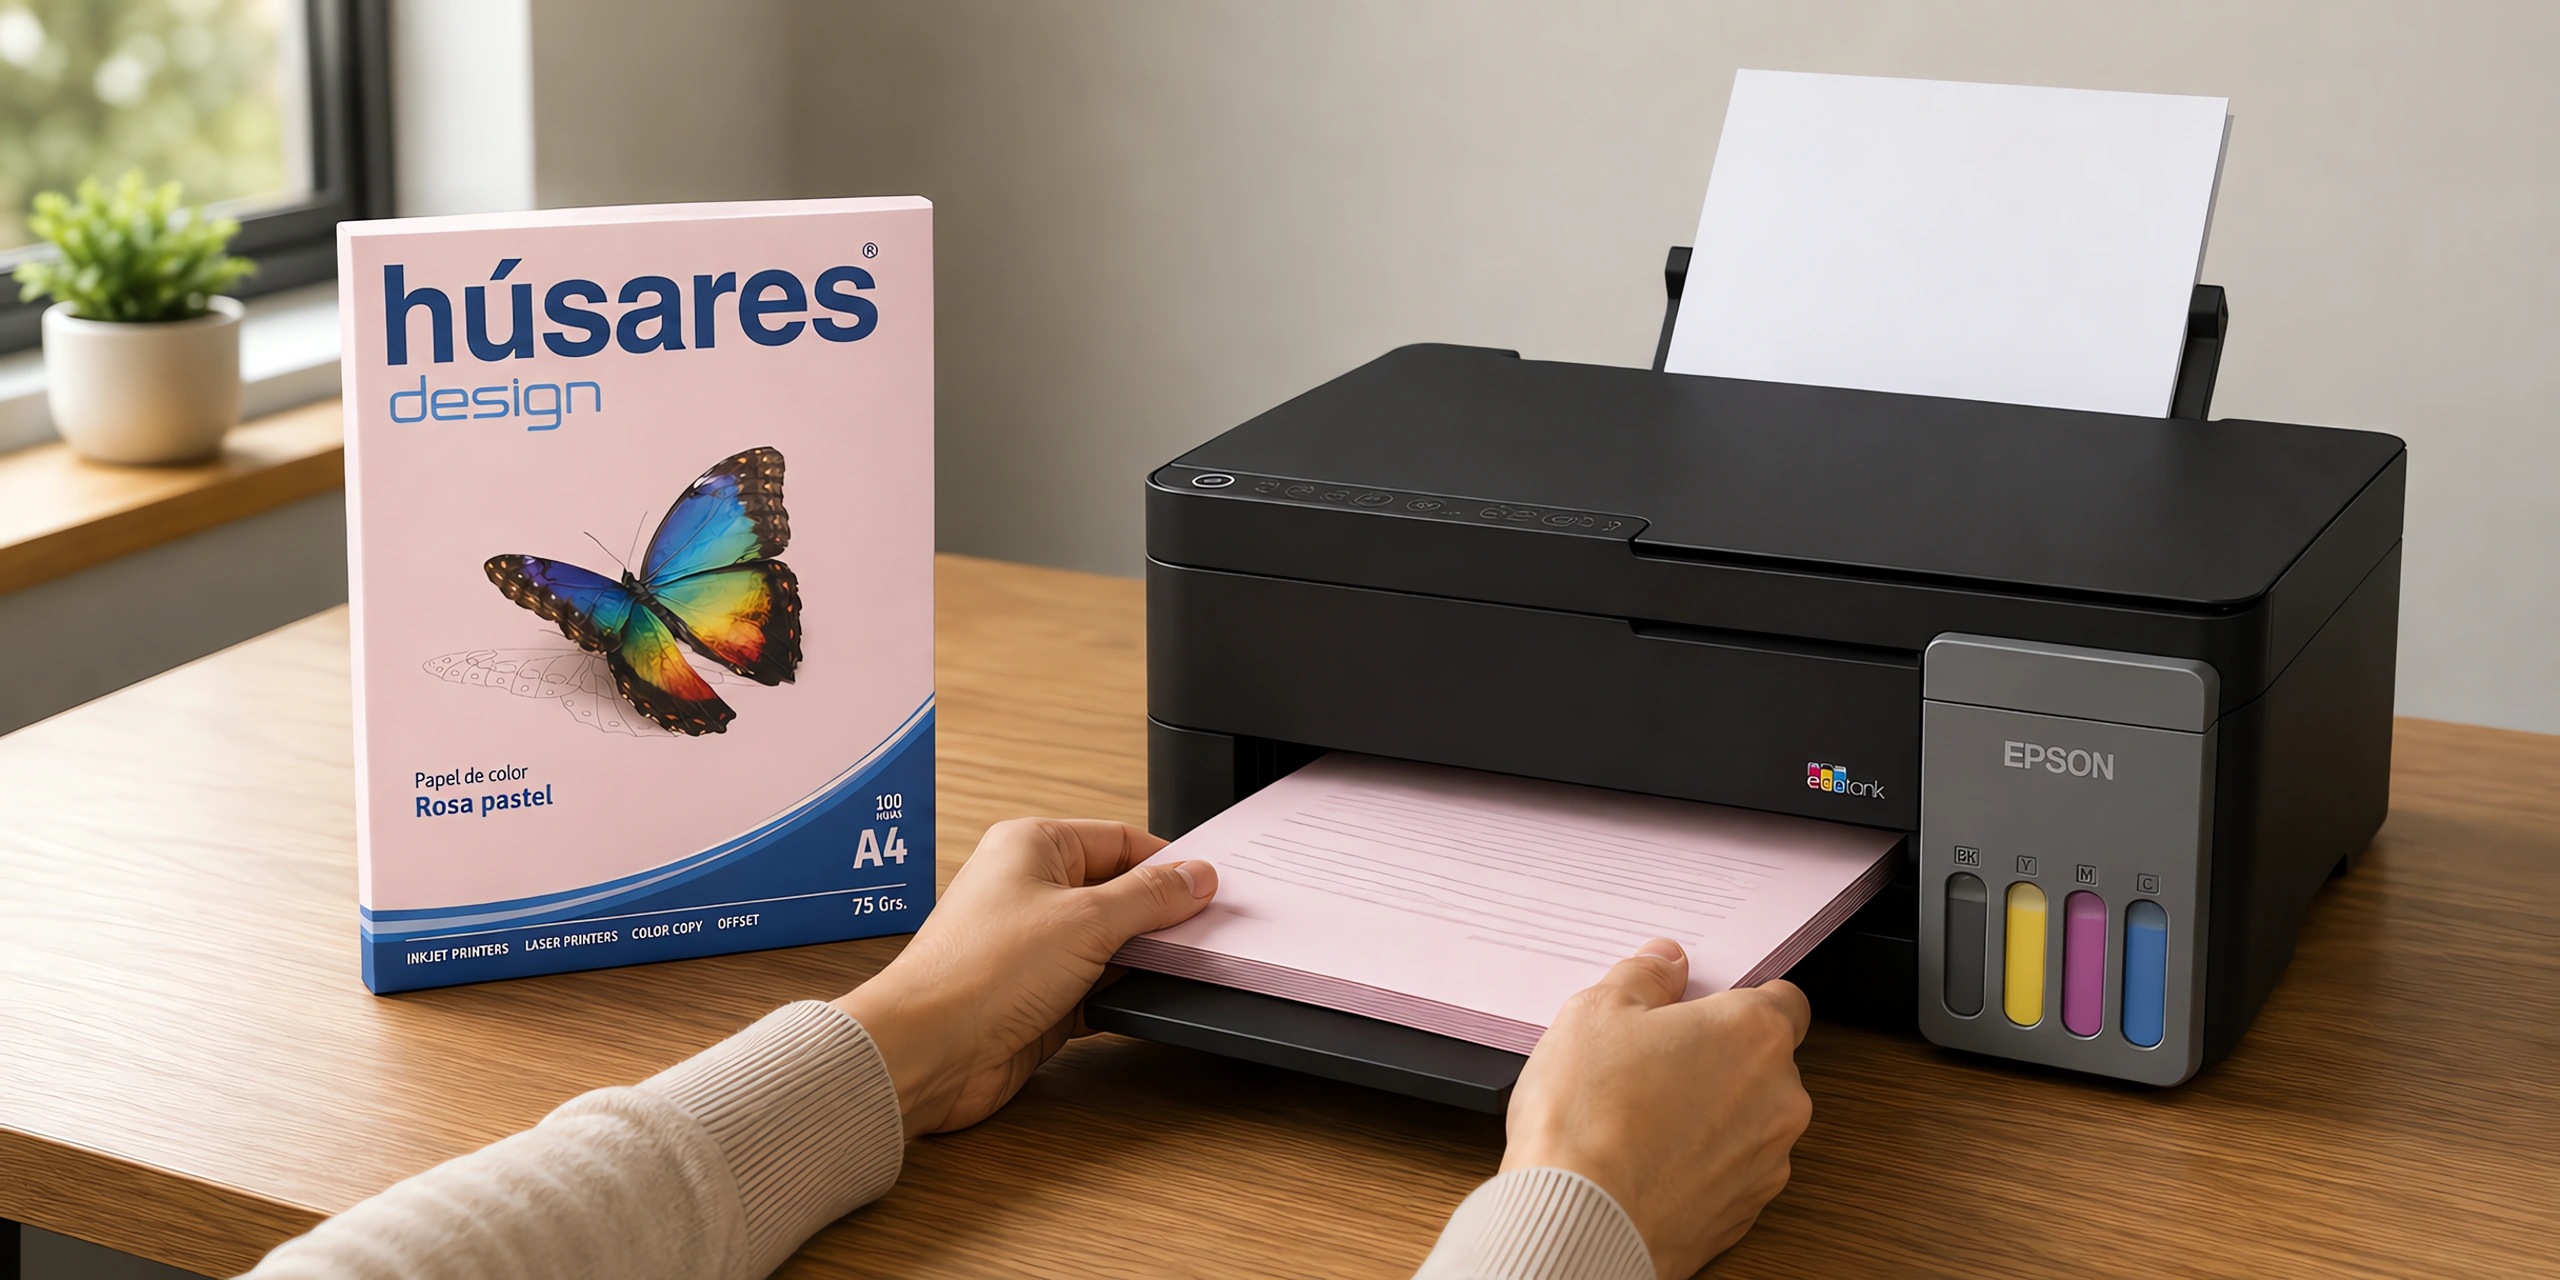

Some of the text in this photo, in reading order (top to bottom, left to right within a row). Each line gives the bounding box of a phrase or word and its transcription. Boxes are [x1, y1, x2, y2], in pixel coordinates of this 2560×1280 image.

[383, 258, 879, 366] húsares
[389, 375, 602, 432] design
[2003, 740, 2115, 781] EPSON
[415, 764, 528, 791] Papel de color
[416, 783, 553, 818] Rosa pastel
[875, 793, 903, 811] 100
[853, 826, 908, 869] A4
[1957, 849, 1977, 865] BK
[2021, 858, 2032, 872] Y
[2079, 867, 2093, 883] M
[2142, 877, 2154, 891] C
[852, 895, 908, 916] 75 Grs.
[631, 920, 703, 940] COLOR COPY
[717, 913, 760, 930] OFFSET
[525, 930, 619, 952] LASER PRINTERS
[407, 942, 509, 965] INKJET PRINTERS
